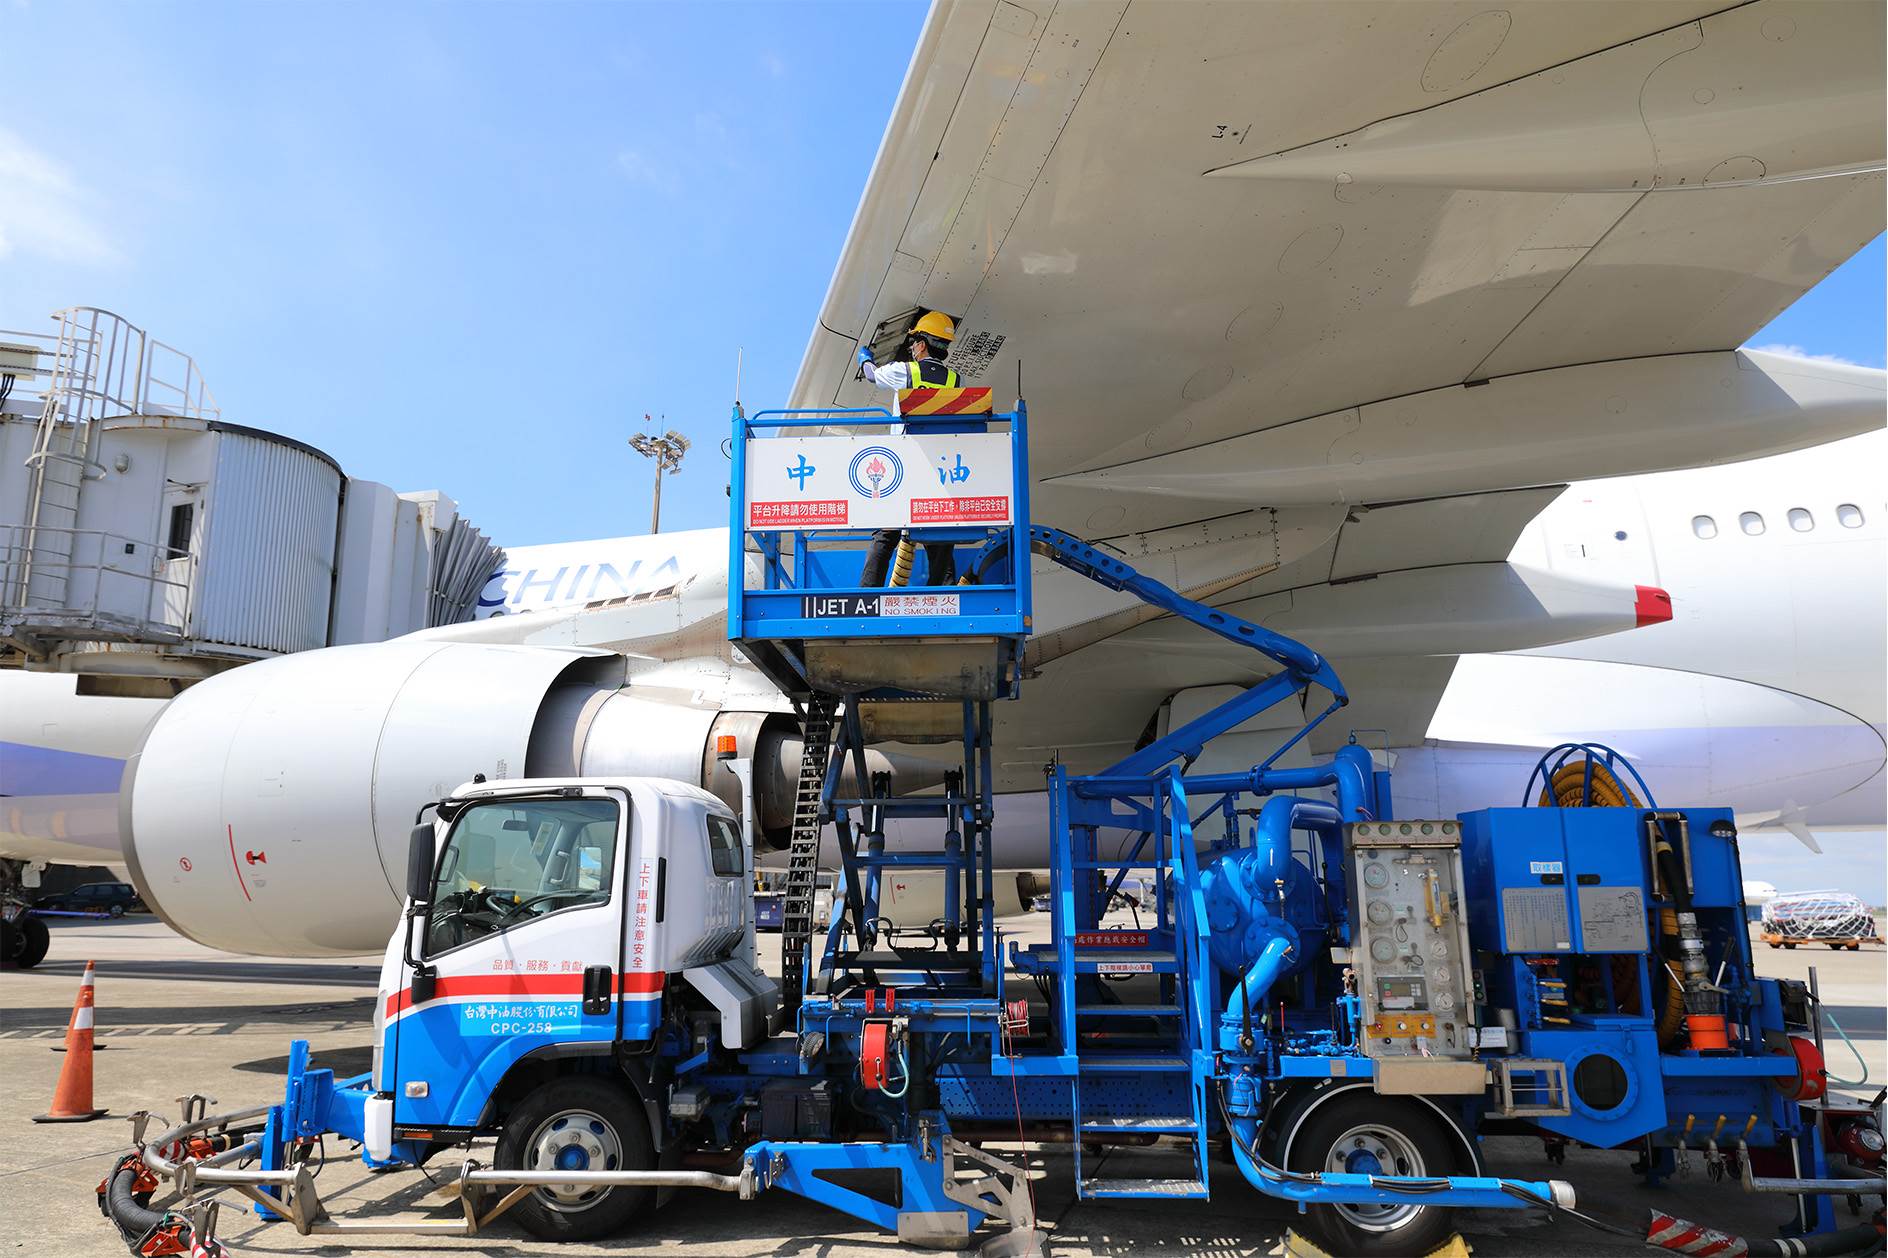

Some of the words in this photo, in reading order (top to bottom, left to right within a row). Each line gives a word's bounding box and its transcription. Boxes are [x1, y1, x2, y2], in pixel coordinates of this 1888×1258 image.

[1211, 125, 1228, 139] L-4
[786, 454, 816, 491] 中
[938, 454, 970, 485] 油
[753, 503, 846, 517] 平台升降請勿使用階梯
[817, 598, 848, 615] JET
[855, 598, 879, 615] A-1
[884, 596, 957, 607] 嚴禁煙火
[885, 608, 900, 616] NO
[903, 607, 957, 616] SMOKING
[632, 863, 650, 969] 上下車請注意安全
[464, 1004, 578, 1020] 台灣中油股份有限公司
[490, 1022, 552, 1034] CPC-258
